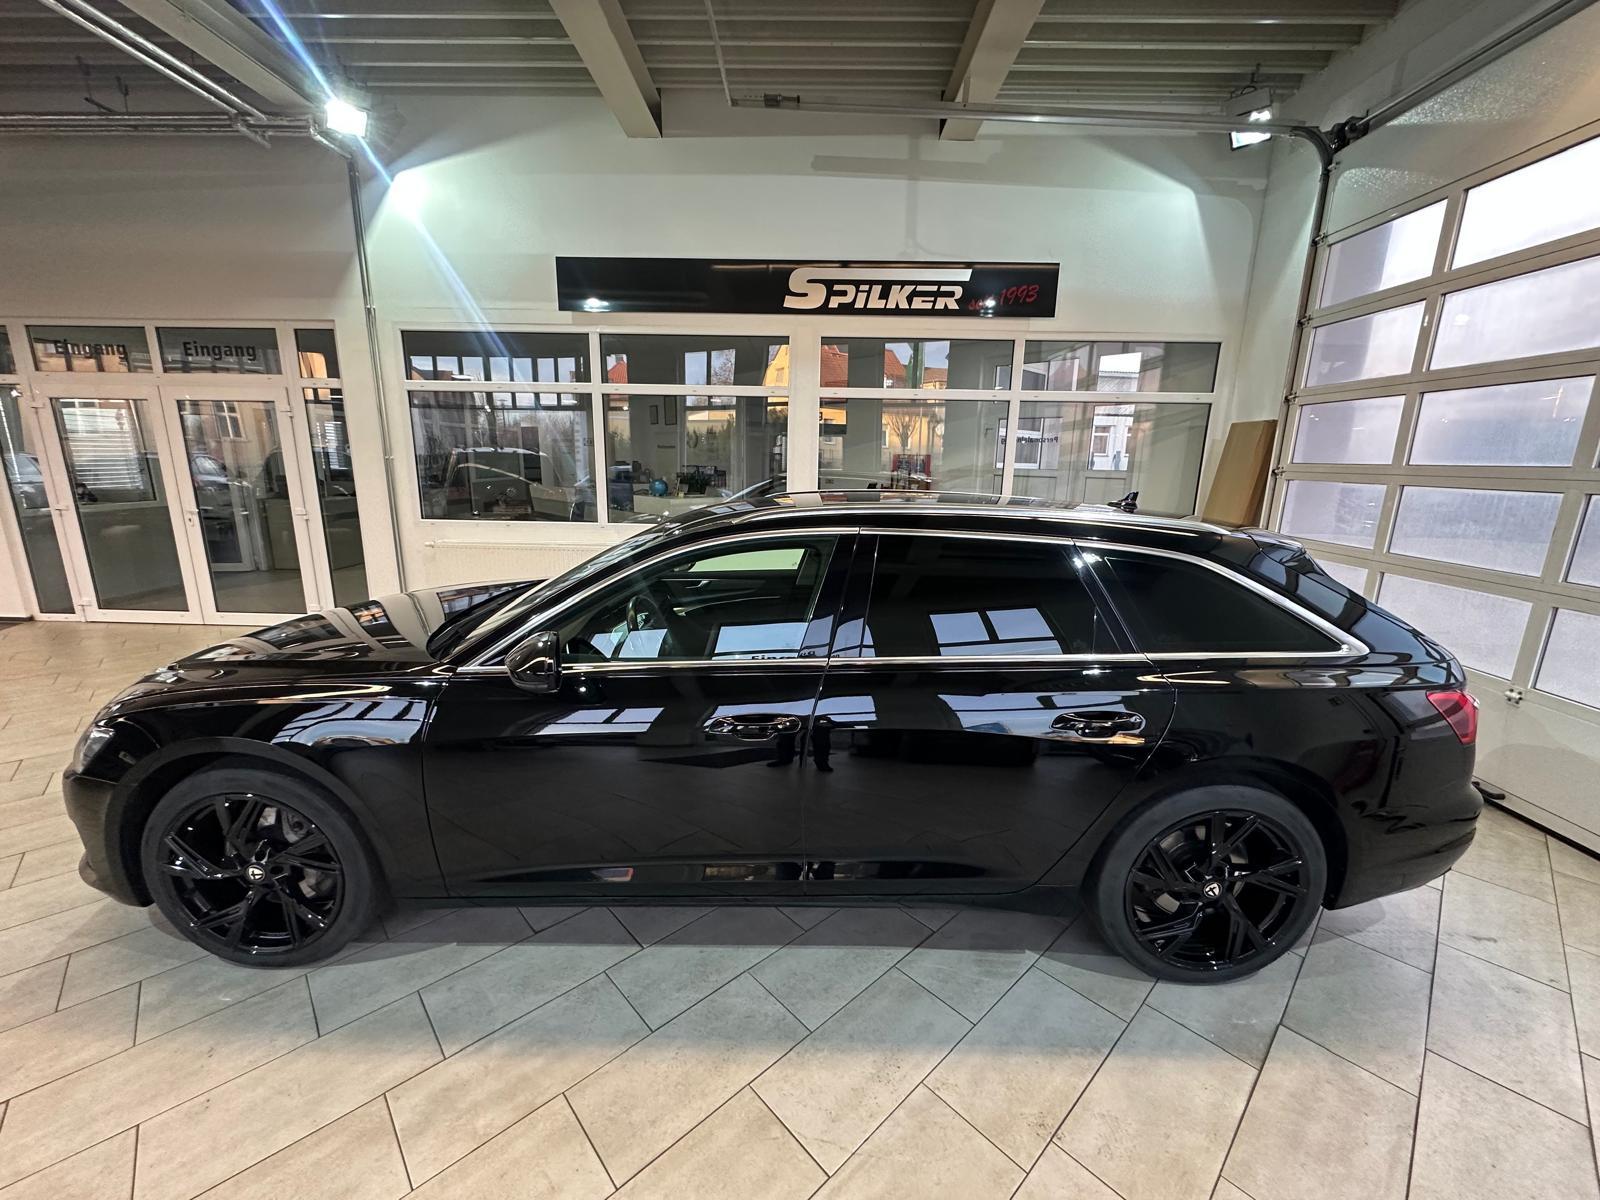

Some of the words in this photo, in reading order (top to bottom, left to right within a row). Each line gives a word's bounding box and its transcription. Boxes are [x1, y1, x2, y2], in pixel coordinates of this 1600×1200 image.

[999, 284, 1040, 305] 1993
[54, 339, 129, 362] Eingang
[182, 341, 257, 361] Eingang
